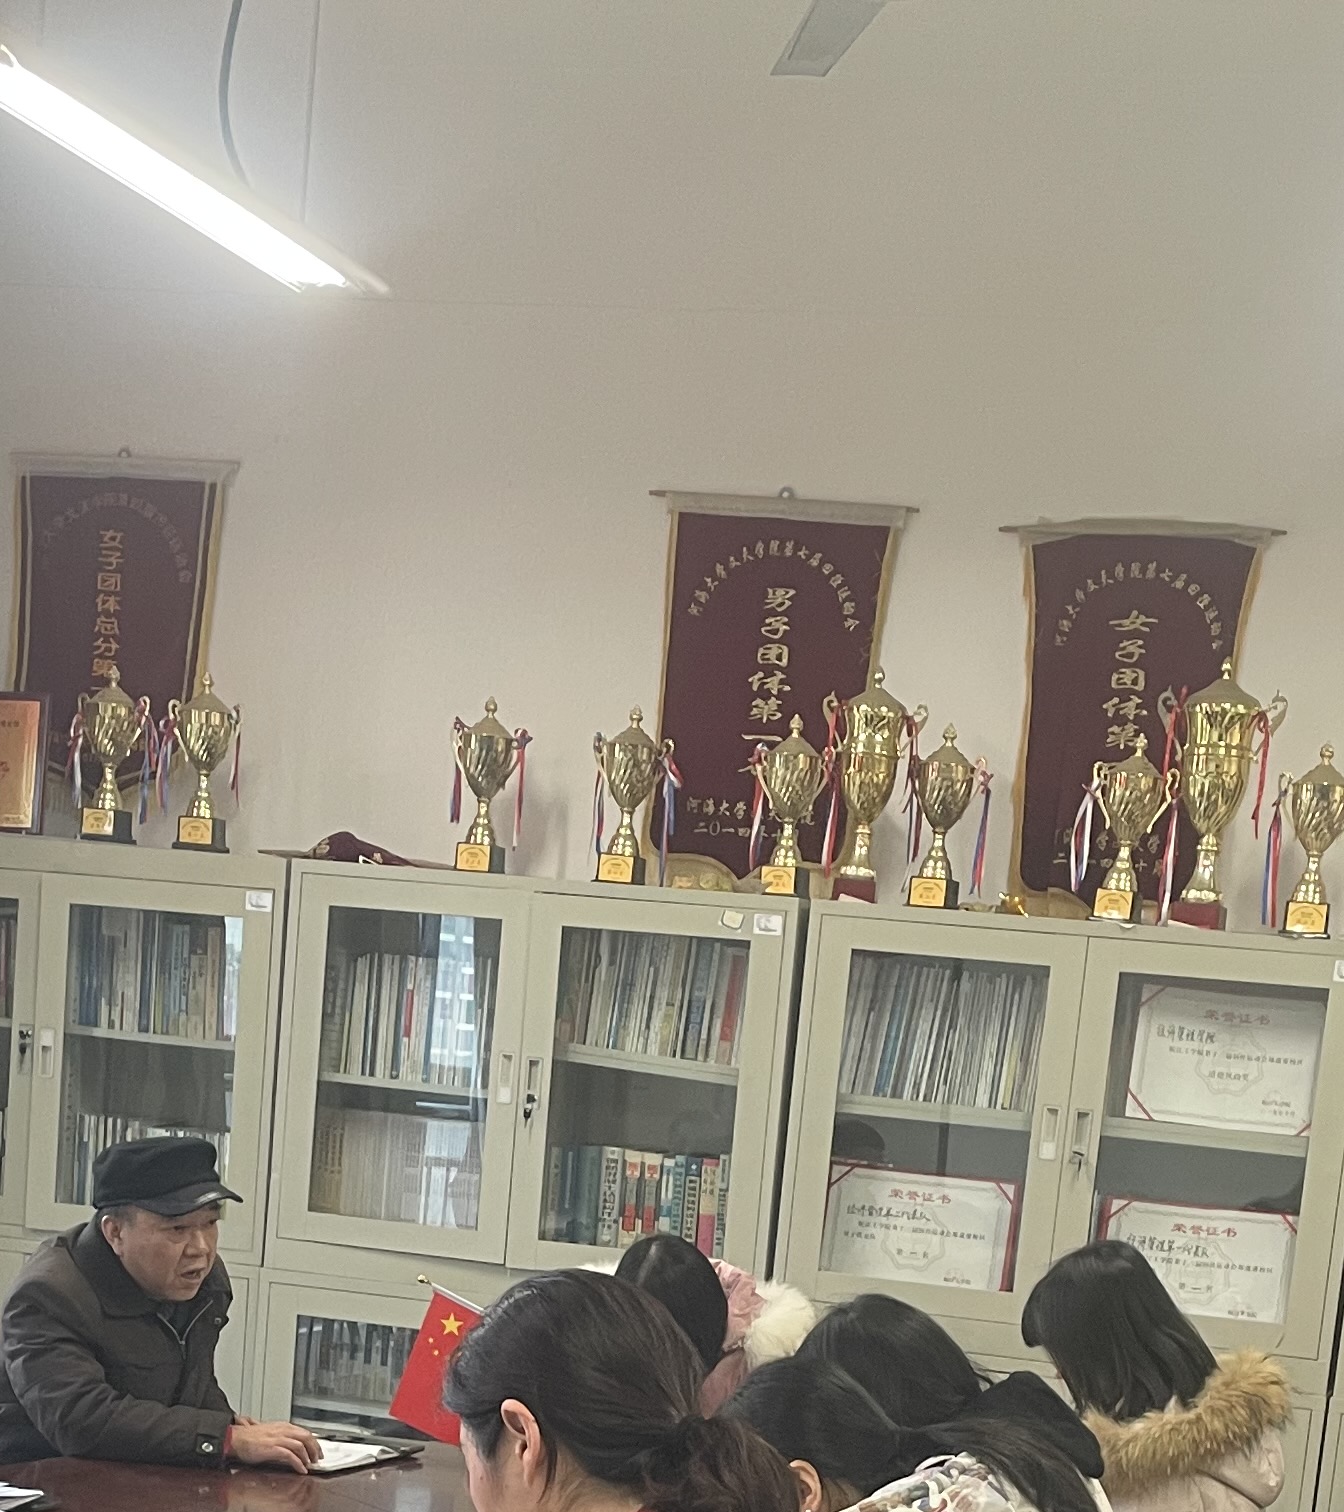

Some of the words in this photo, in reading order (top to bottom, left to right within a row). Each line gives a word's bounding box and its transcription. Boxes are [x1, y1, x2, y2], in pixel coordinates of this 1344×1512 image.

[1204, 1009, 1270, 1025] 荣誉证书
[888, 1188, 952, 1204] 荣誉证书
[1171, 1223, 1238, 1238] 荣誉证书
